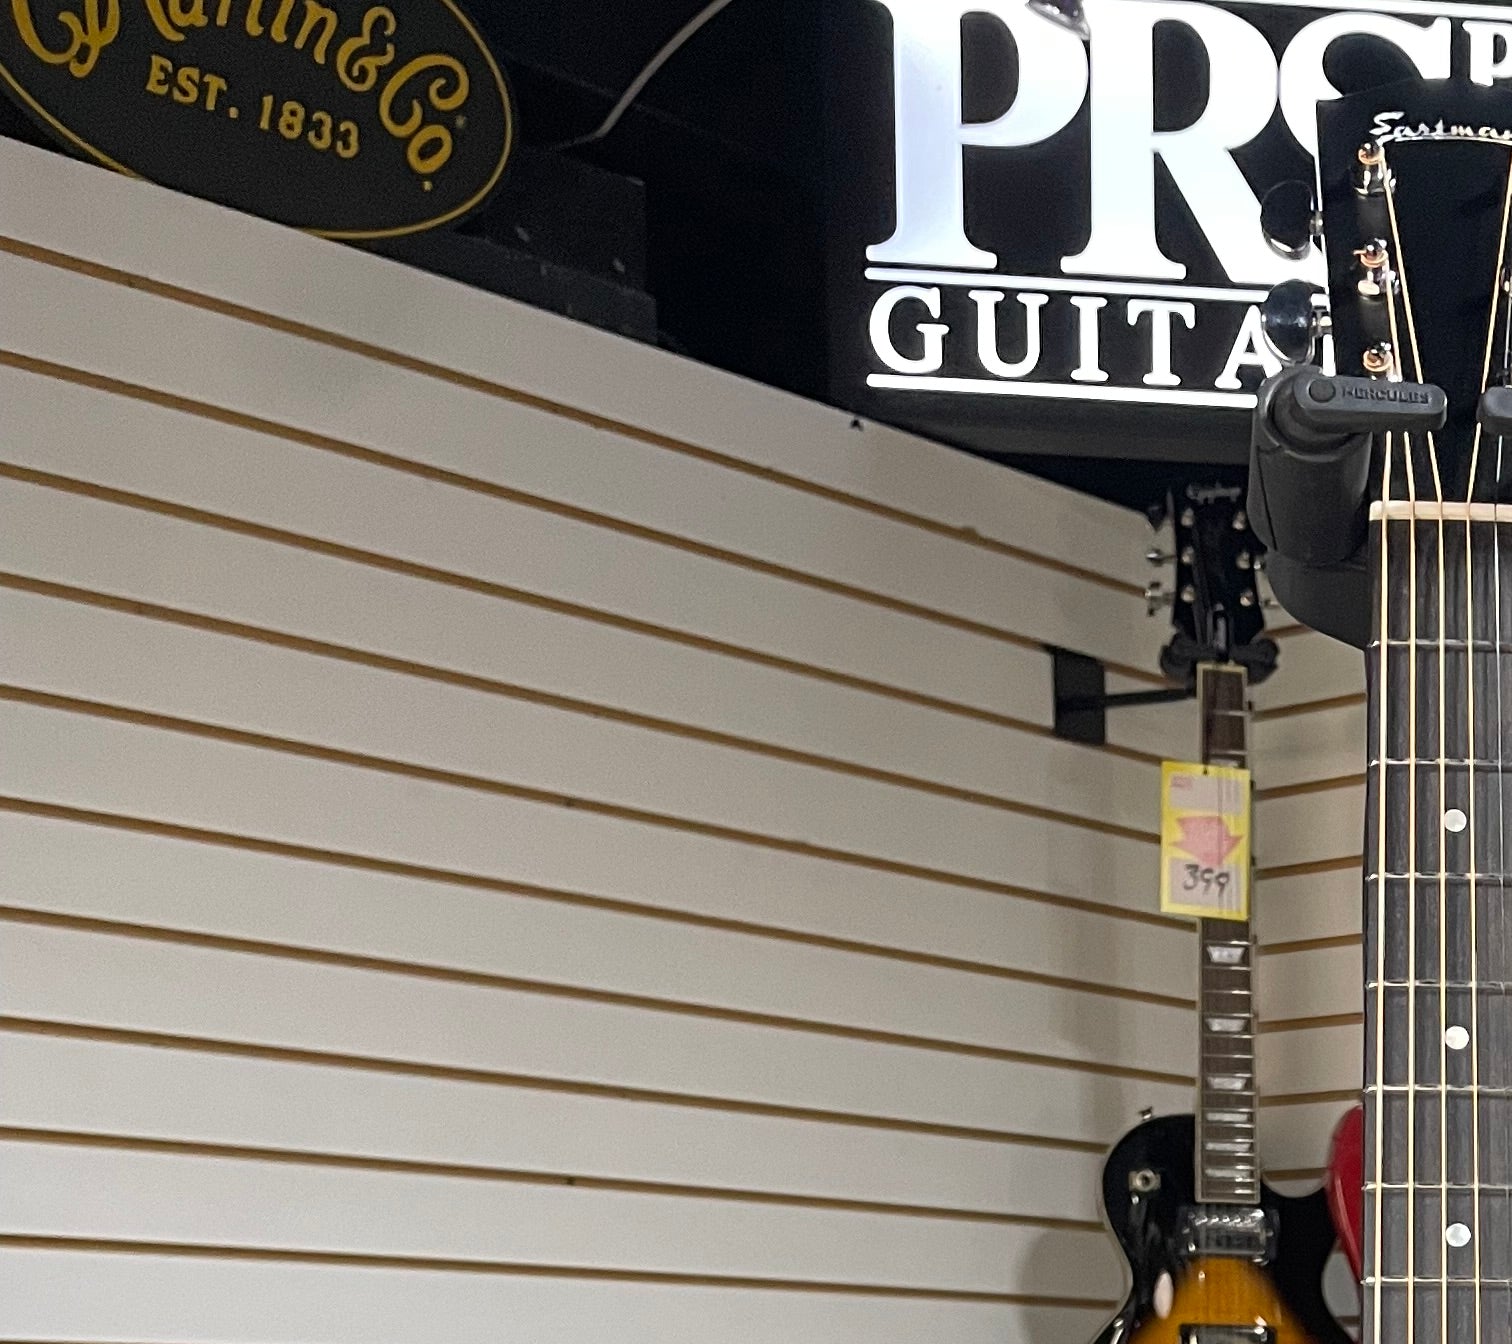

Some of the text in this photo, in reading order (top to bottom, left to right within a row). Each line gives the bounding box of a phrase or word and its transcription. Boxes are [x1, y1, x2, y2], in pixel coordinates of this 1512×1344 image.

[146, 54, 361, 160] EST. 1833
[1183, 863, 1231, 898] 399
